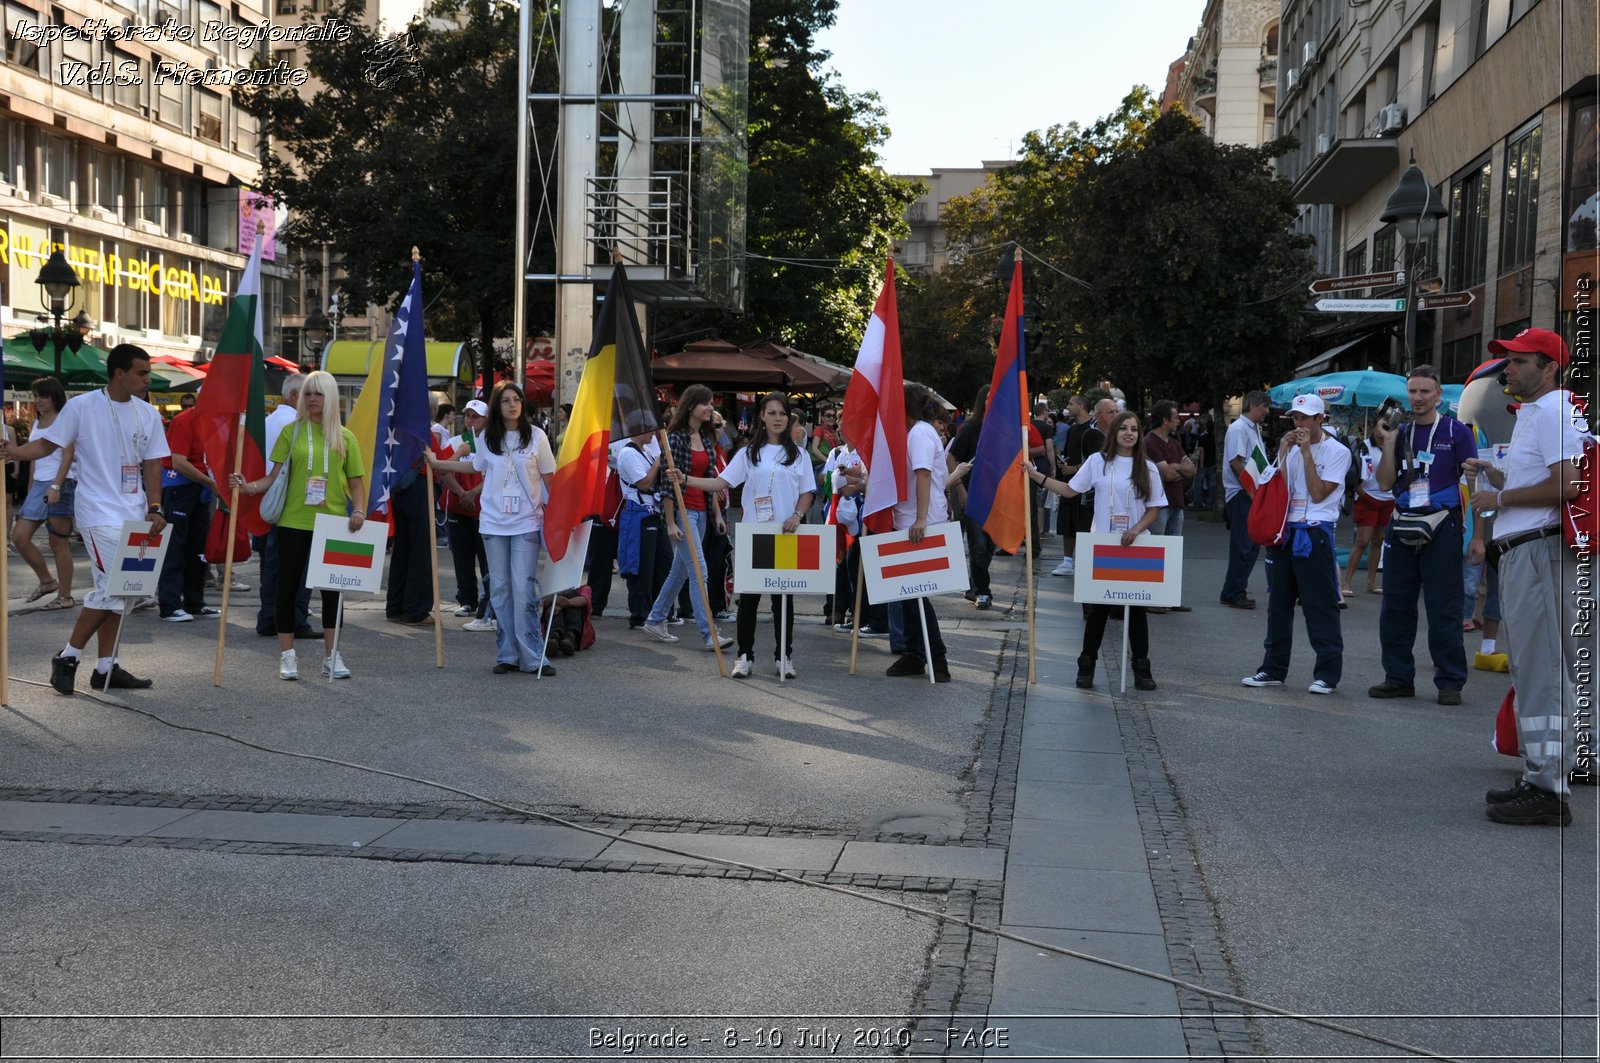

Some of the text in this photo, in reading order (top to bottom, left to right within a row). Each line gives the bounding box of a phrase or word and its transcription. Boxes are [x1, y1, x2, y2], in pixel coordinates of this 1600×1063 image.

[128, 257, 223, 306] BEOGRADA
[123, 580, 144, 592] Croatia
[329, 573, 362, 588] Bulgaria
[764, 577, 807, 590] Belgium
[899, 581, 938, 595] Austria
[1103, 589, 1152, 601] Armenia
